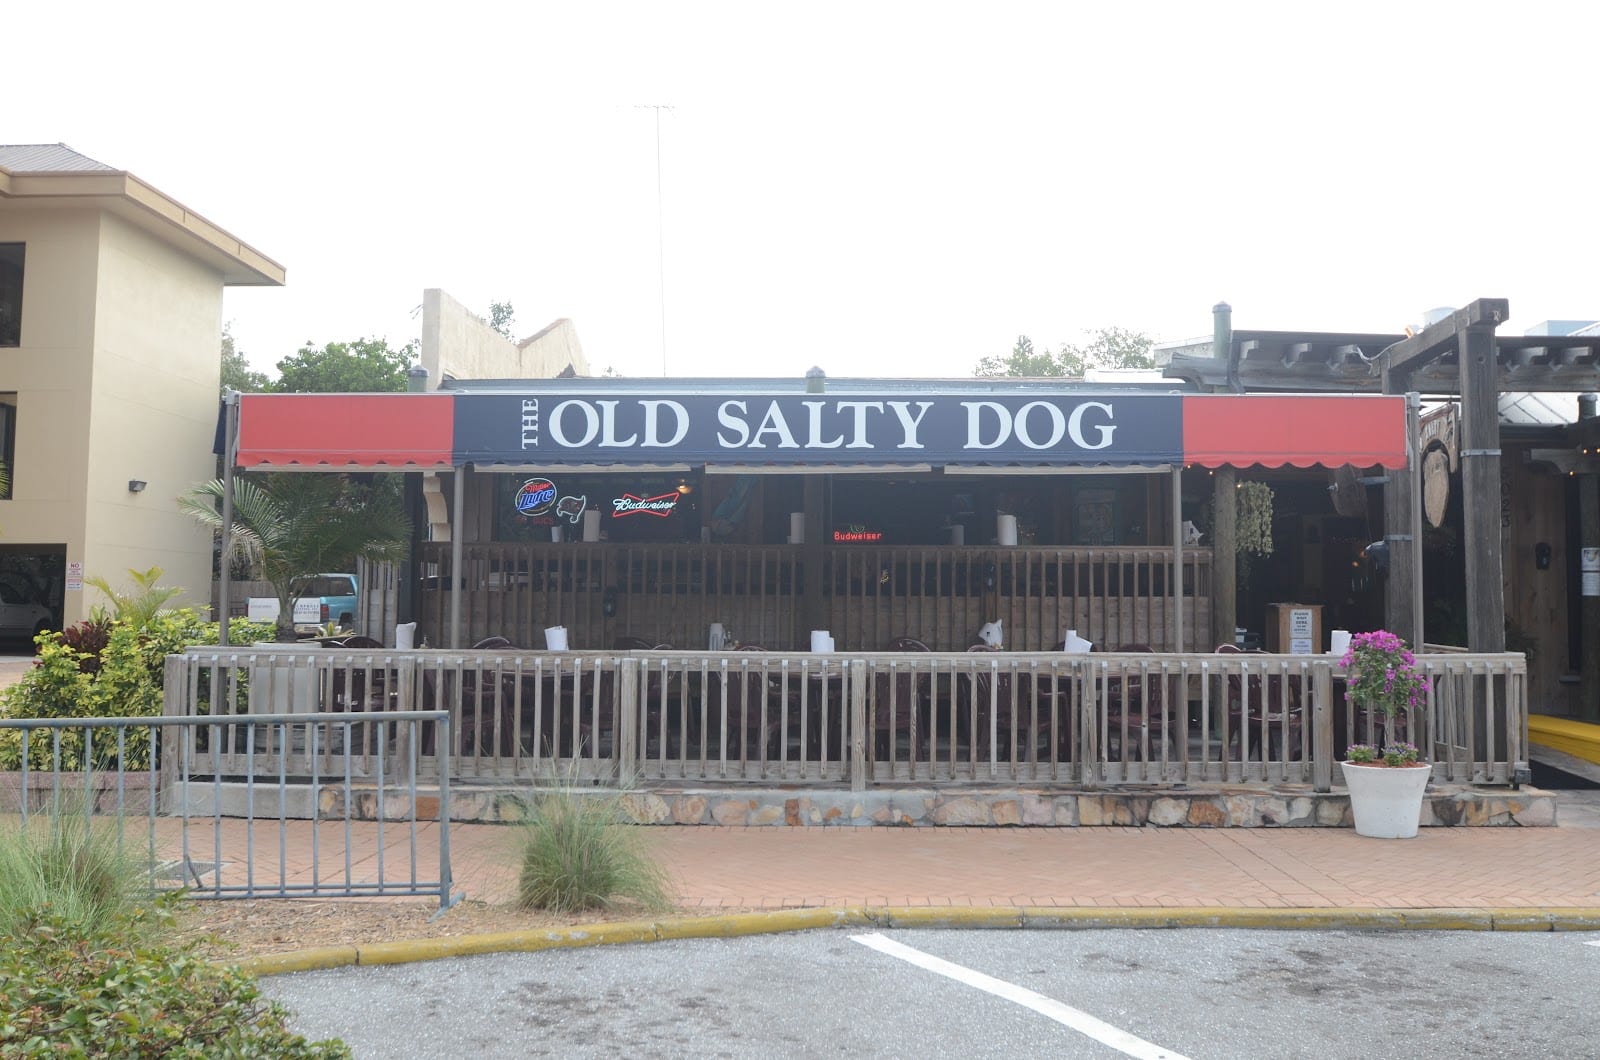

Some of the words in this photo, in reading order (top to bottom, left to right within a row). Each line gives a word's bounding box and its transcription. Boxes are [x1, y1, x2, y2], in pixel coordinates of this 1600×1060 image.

[522, 398, 539, 449] THE
[548, 400, 689, 448] OLD
[717, 400, 934, 449] SALTY
[960, 401, 1118, 450] DOG
[612, 498, 676, 511] Budweiser
[834, 531, 882, 540] Budweiser
